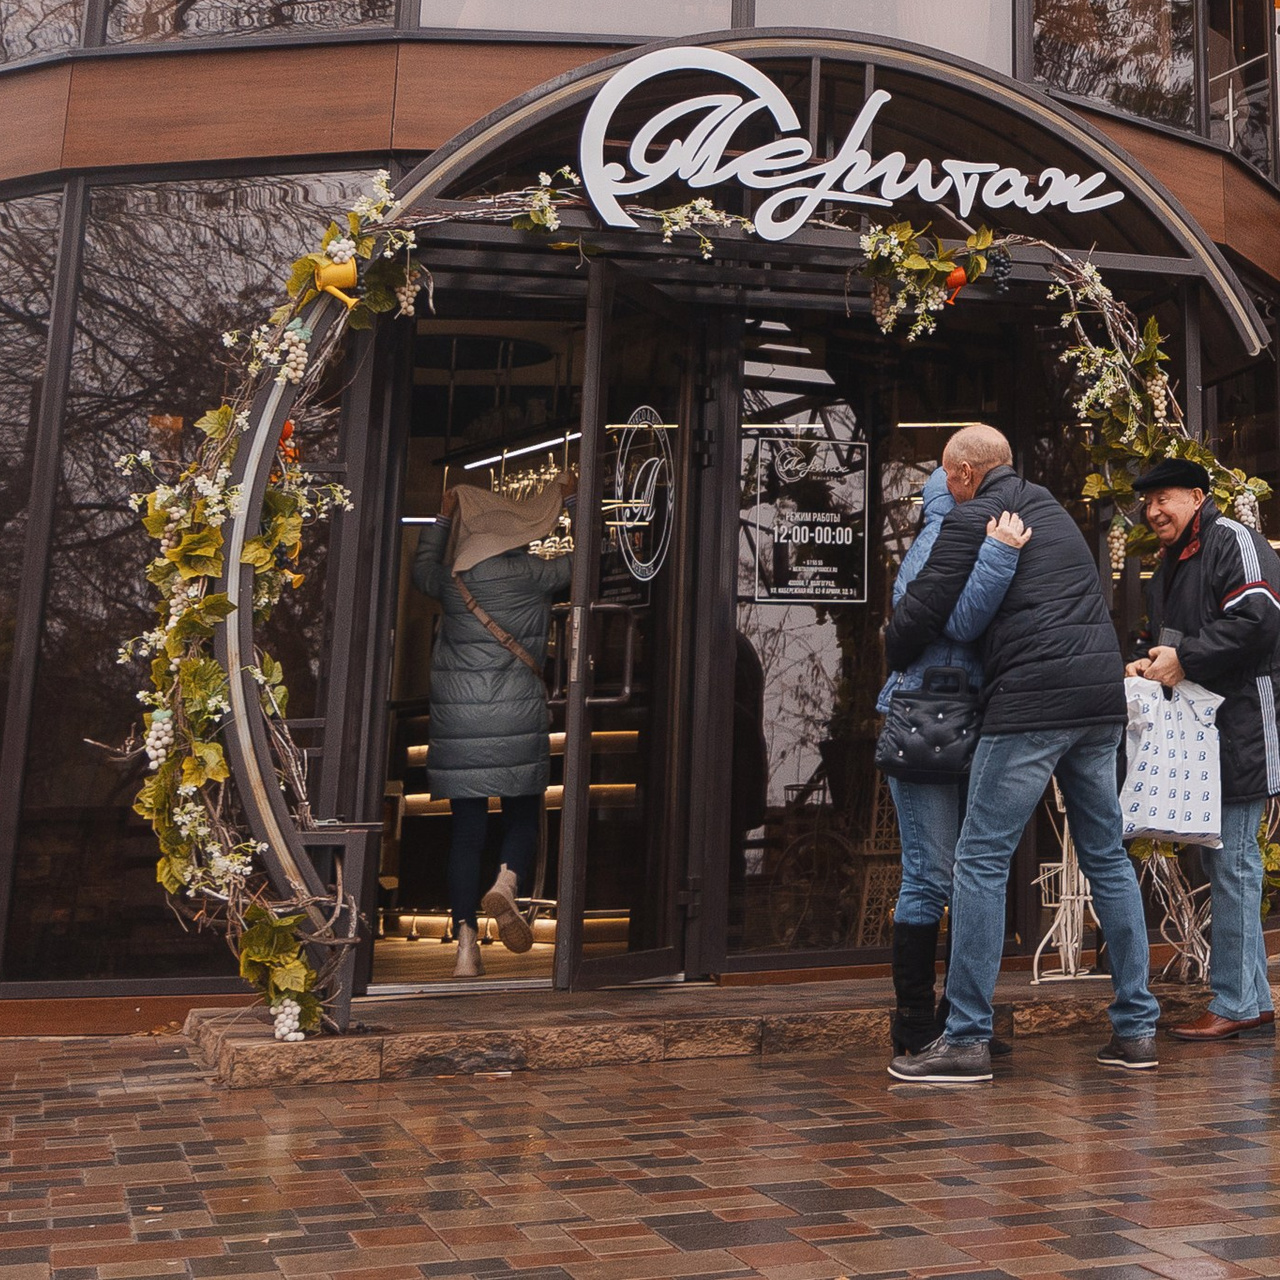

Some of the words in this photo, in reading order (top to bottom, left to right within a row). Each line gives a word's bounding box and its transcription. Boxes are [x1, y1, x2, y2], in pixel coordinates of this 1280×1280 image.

[580, 46, 1126, 242] Меритаж
[786, 511, 812, 522] РЕЖИМ
[812, 512, 841, 523] РАБОТЫ
[773, 525, 853, 545] 12:00-00:00
